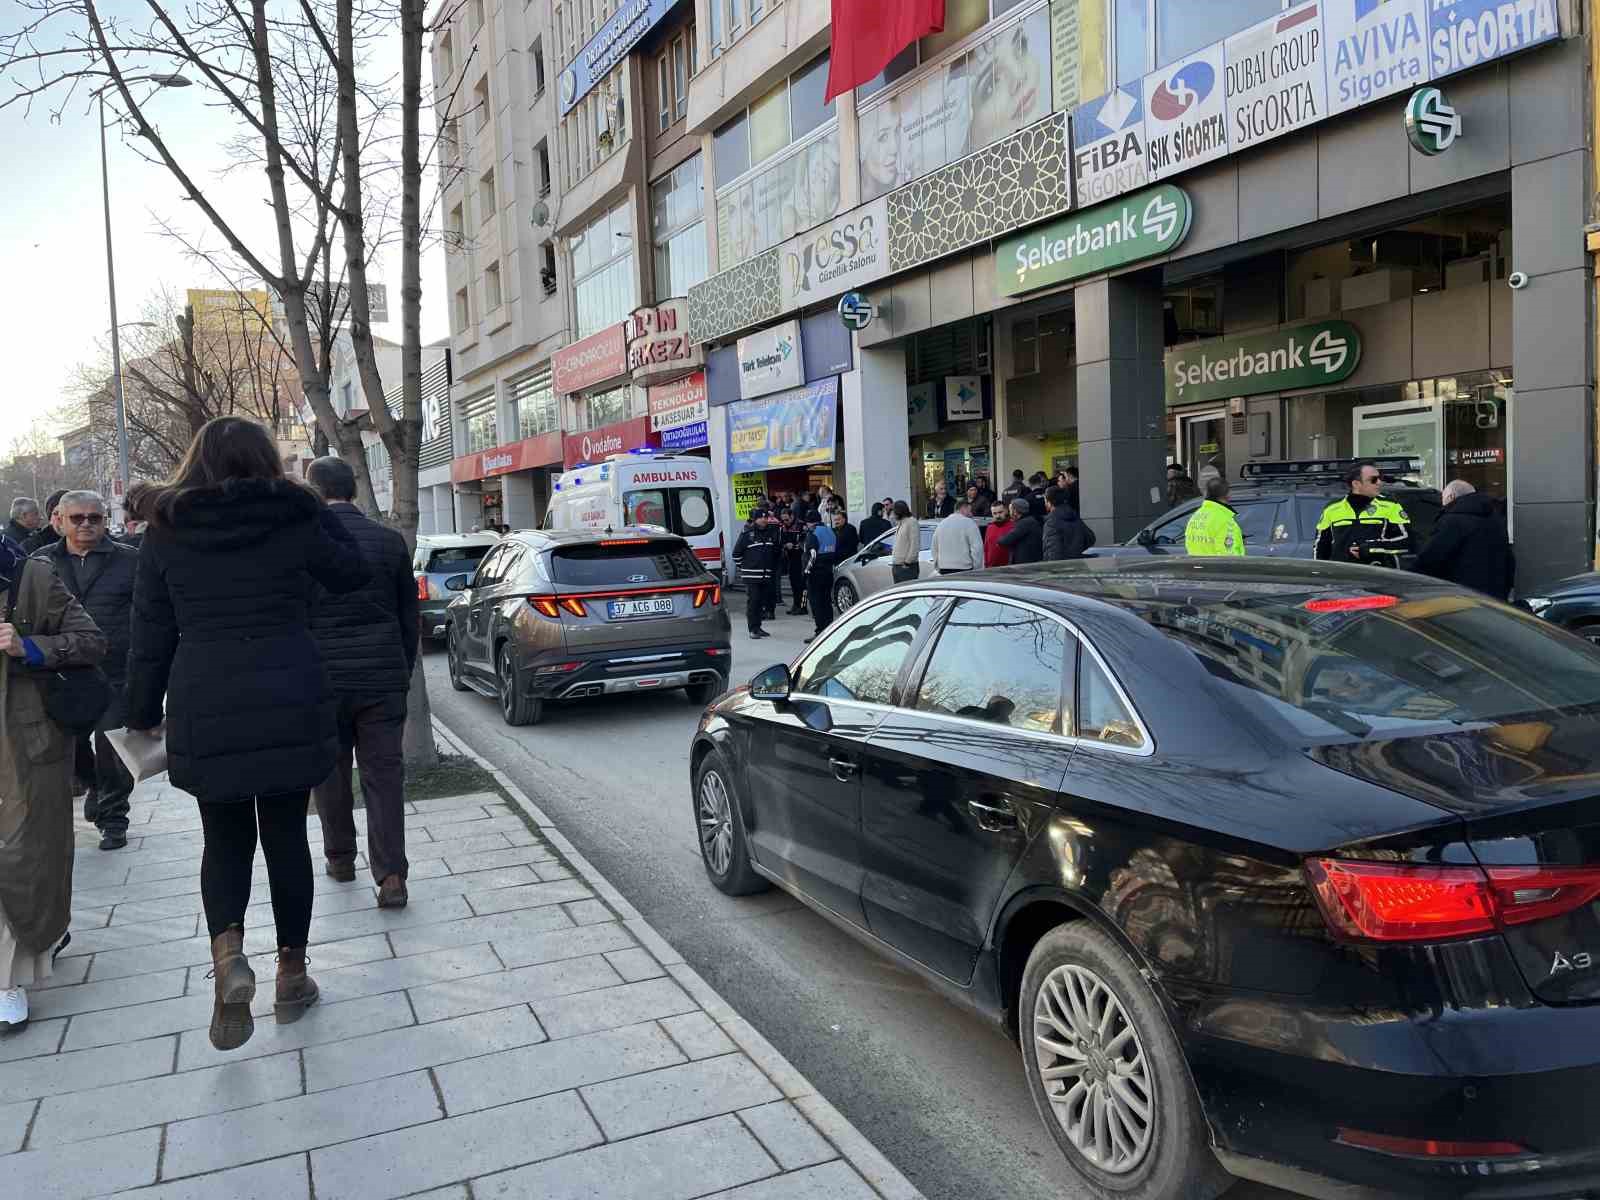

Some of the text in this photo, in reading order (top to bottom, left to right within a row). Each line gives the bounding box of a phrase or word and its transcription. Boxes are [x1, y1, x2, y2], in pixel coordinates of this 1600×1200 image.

[1226, 29, 1319, 98] DUBAI GROUP
[1335, 12, 1421, 75] AVIVA
[1339, 56, 1421, 102] Sigorta
[1174, 113, 1227, 163] SİGORTA
[1016, 207, 1138, 283] Şekerbank
[819, 254, 876, 283] Güzellik Salonu
[1174, 337, 1305, 396] Şekerbank
[592, 435, 622, 455] vodafone
[633, 470, 698, 484] AMBULANS
[616, 603, 626, 614] 37
[1550, 951, 1592, 975] A3
